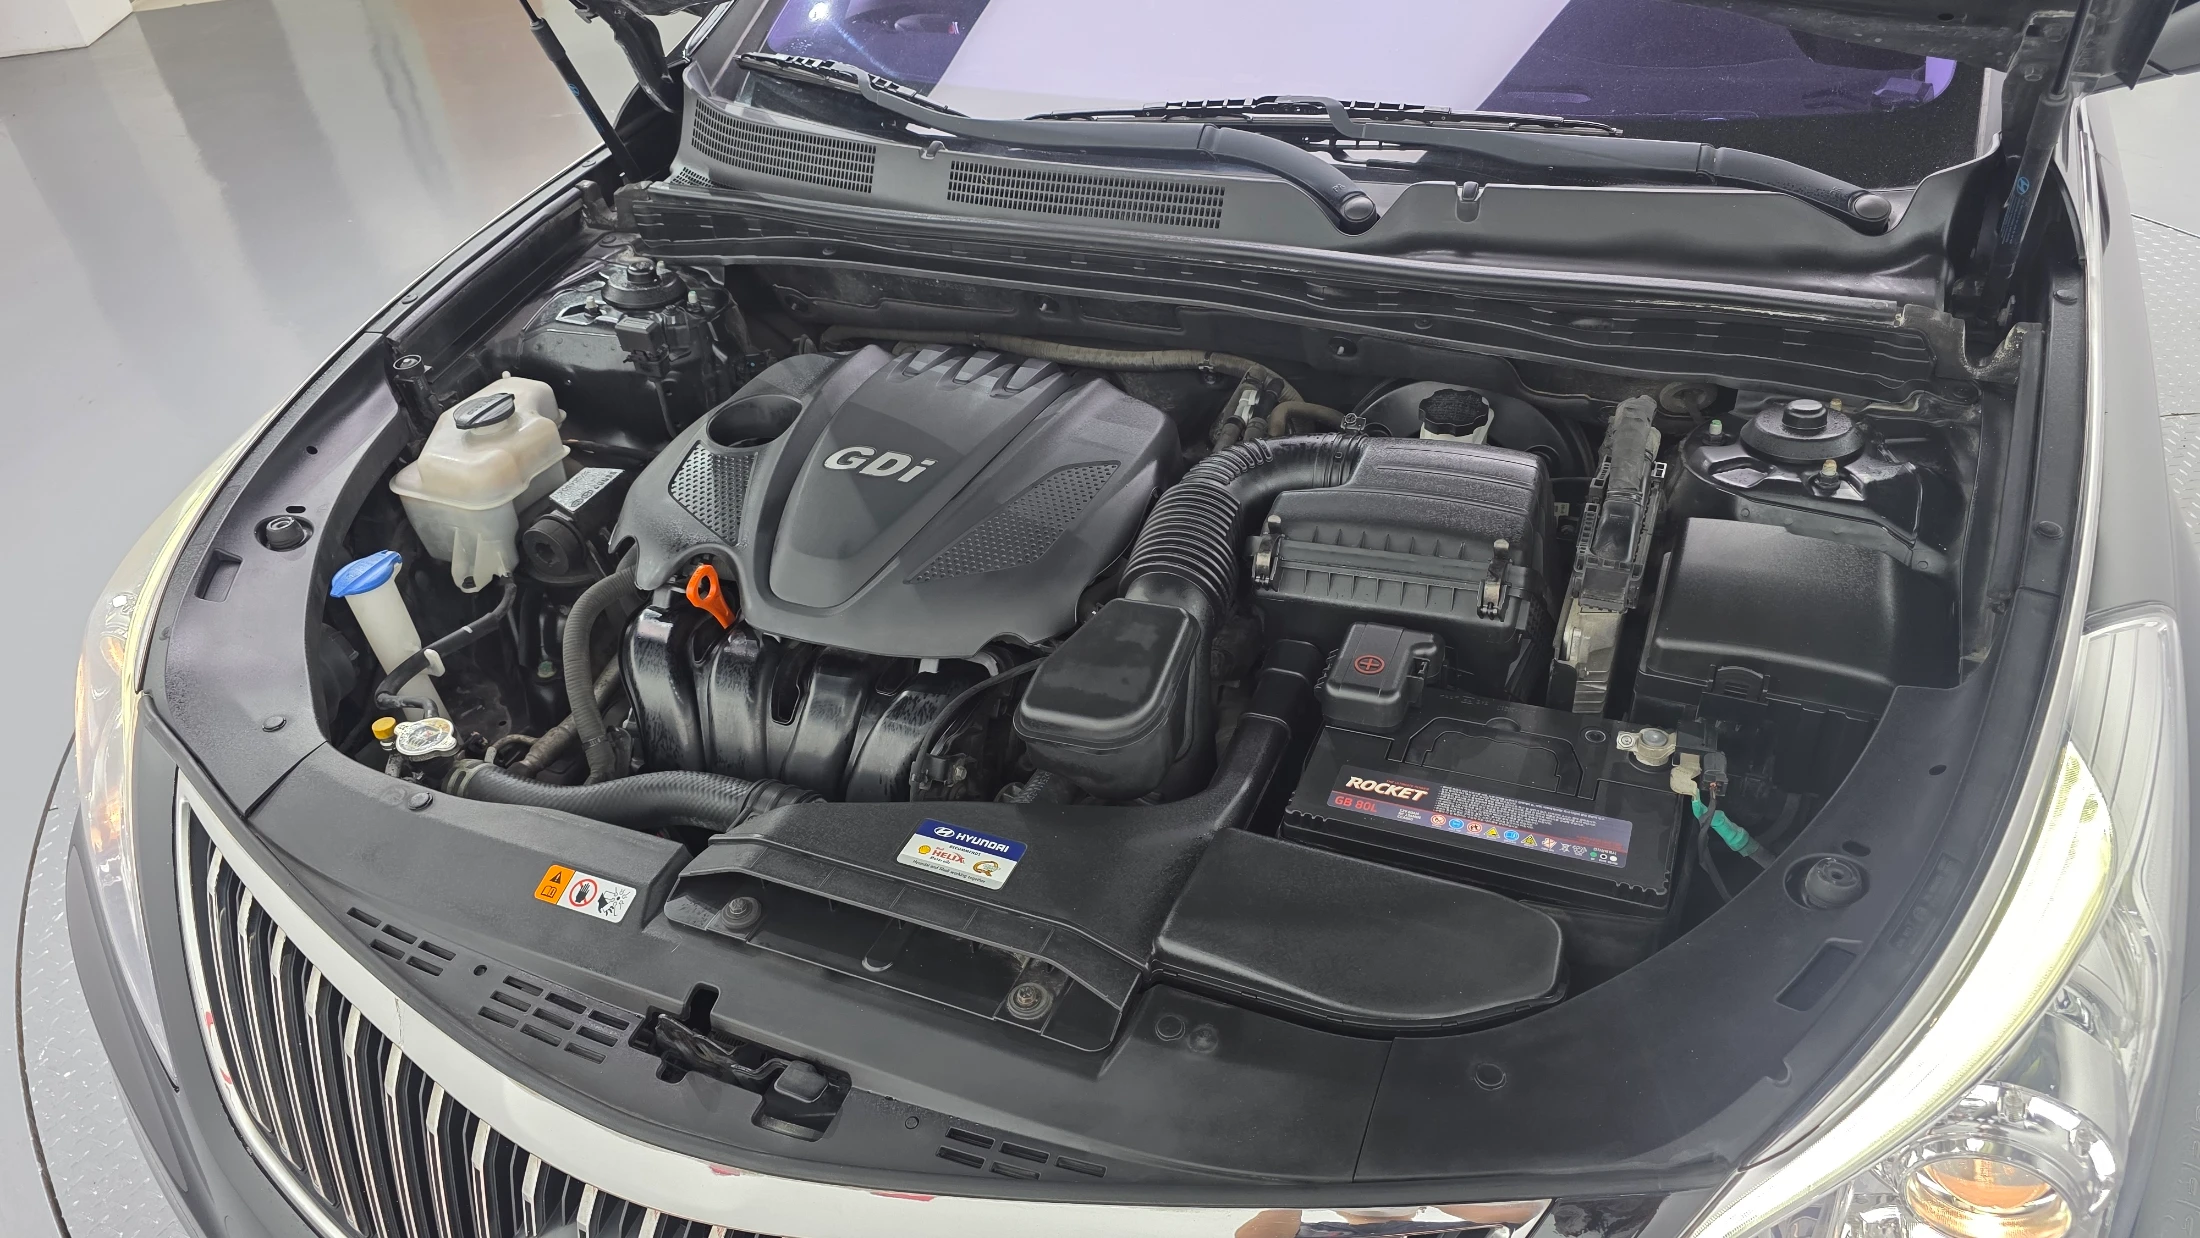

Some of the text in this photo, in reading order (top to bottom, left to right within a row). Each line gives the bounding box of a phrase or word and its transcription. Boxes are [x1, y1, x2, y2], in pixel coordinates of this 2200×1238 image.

[823, 445, 938, 483] GDi
[1345, 776, 1428, 801] ROCKET
[1334, 796, 1377, 812] GB 80L
[955, 832, 1010, 853] HYUNDAI
[932, 849, 966, 864] HELIX
